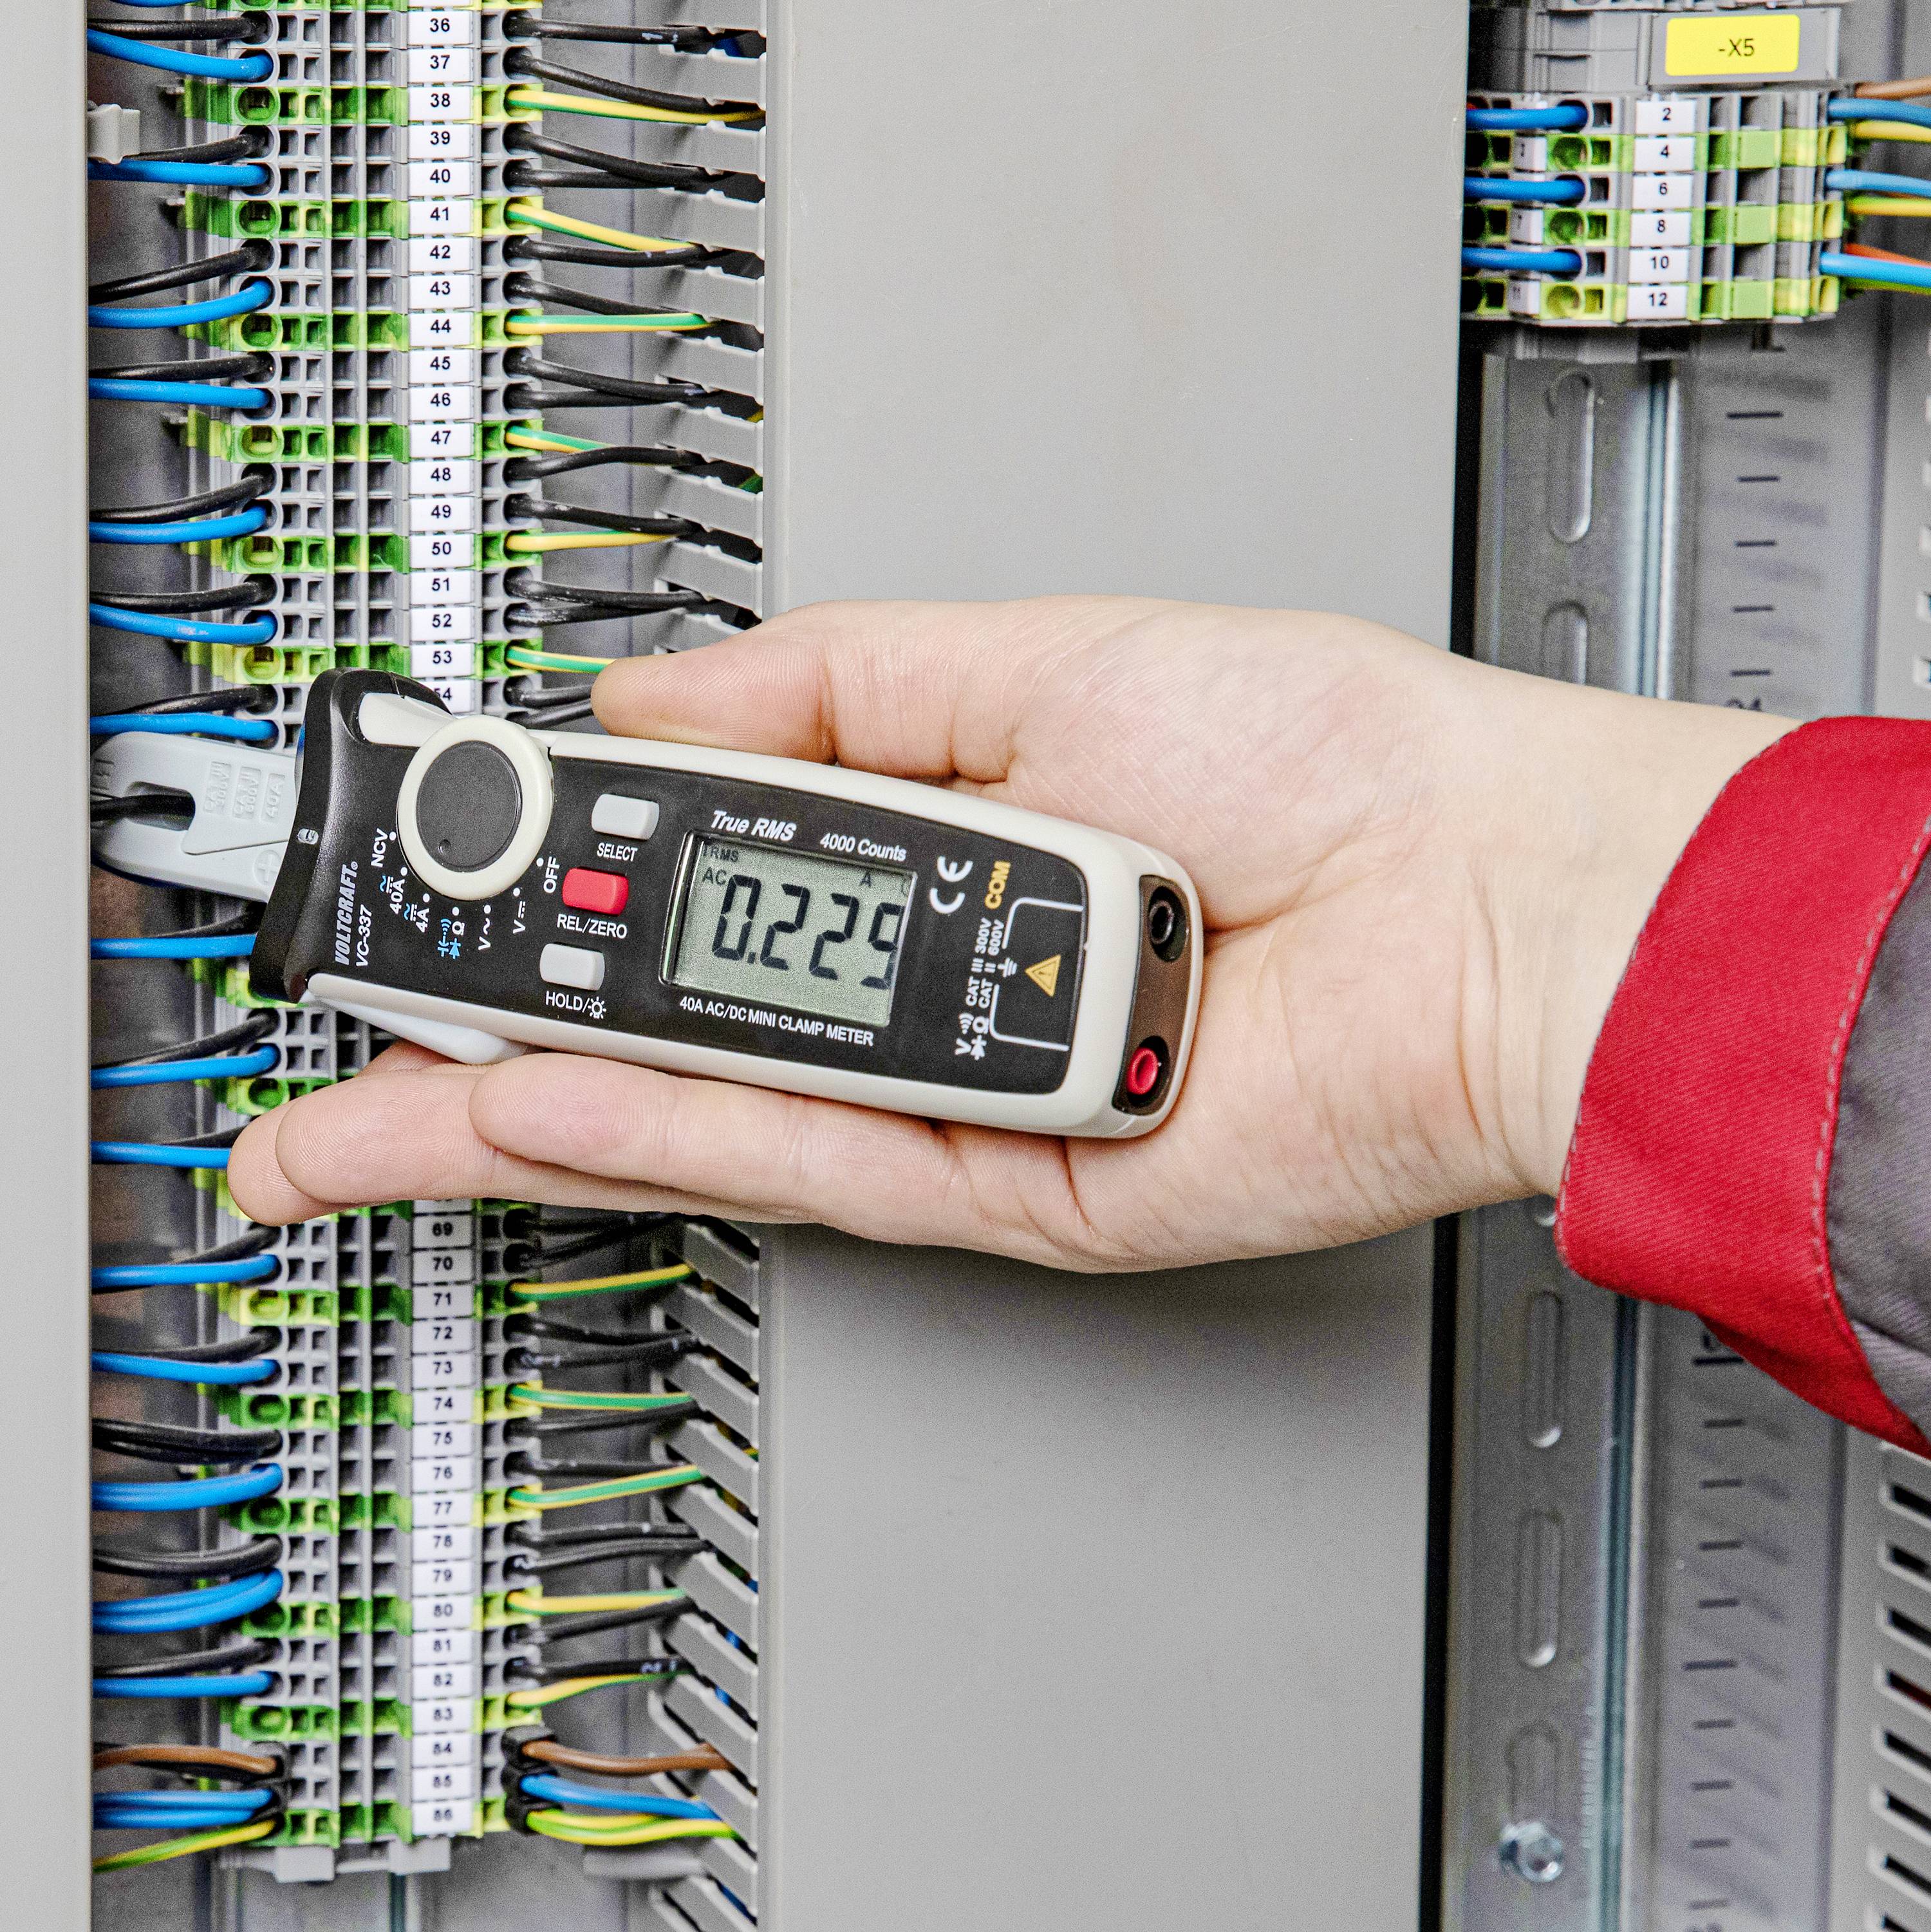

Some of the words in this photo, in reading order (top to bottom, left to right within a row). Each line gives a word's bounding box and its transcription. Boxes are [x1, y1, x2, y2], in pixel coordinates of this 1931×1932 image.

[429, 17, 451, 33] 36
[1718, 37, 1755, 57] -X5
[430, 54, 451, 70] 37
[430, 93, 451, 108] 38
[1662, 107, 1671, 122] 2
[430, 131, 451, 145] 39
[1660, 145, 1670, 158] 4
[429, 169, 451, 183] 40
[1659, 182, 1668, 196] 6
[430, 207, 449, 221] 41
[1657, 219, 1666, 233] 8
[429, 245, 451, 259] 42
[1651, 255, 1670, 270] 10
[429, 281, 451, 295] 43
[1649, 292, 1667, 306] 12
[430, 319, 451, 333] 44
[430, 355, 451, 370] 45
[430, 392, 451, 407] 46
[431, 430, 451, 445] 47
[430, 467, 451, 482] 48
[431, 504, 451, 519] 49
[431, 541, 452, 556] 50
[431, 577, 450, 592] 51
[432, 613, 452, 628] 52
[433, 650, 452, 665] 53
[434, 687, 452, 701] 54
[710, 810, 750, 834] True
[751, 818, 798, 841] RMS
[371, 828, 389, 867] NCV
[596, 842, 638, 861] SELECT
[819, 832, 855, 852] 4000
[857, 838, 908, 861] Counts
[543, 856, 560, 893] OFF
[702, 867, 727, 886] AC
[859, 871, 872, 888] A
[984, 860, 1011, 910] COM
[389, 878, 406, 914] 40A
[415, 908, 430, 933] 4A
[513, 919, 527, 934] V
[557, 914, 628, 939] REL/ZERO
[356, 904, 372, 966] VC-337
[975, 917, 992, 953] 300V
[987, 919, 1004, 956] 600V
[478, 936, 491, 950] V
[971, 957, 984, 973] III
[984, 962, 996, 973] II
[965, 975, 981, 1007] CAT
[978, 978, 993, 1009] CAT
[679, 996, 704, 1013] 40A
[705, 1004, 747, 1022] AC/DC
[747, 1010, 776, 1027] MINI
[778, 1015, 825, 1036] CLAMP
[825, 1023, 874, 1047] METER
[955, 1038, 972, 1055] V
[433, 1255, 454, 1271] 70
[433, 1292, 451, 1306] 71
[433, 1326, 452, 1340] 72
[433, 1360, 453, 1374] 73
[434, 1397, 453, 1409] 74
[434, 1431, 452, 1445] 75
[433, 1466, 453, 1479] 76
[434, 1501, 452, 1515] 77
[434, 1534, 452, 1548] 78
[433, 1569, 452, 1582] 79
[433, 1604, 453, 1617] 80
[433, 1639, 451, 1652] 81
[433, 1673, 452, 1687] 82
[433, 1707, 452, 1721] 83
[433, 1742, 452, 1754] 84
[433, 1774, 452, 1788] 85
[434, 1808, 452, 1821] 86
